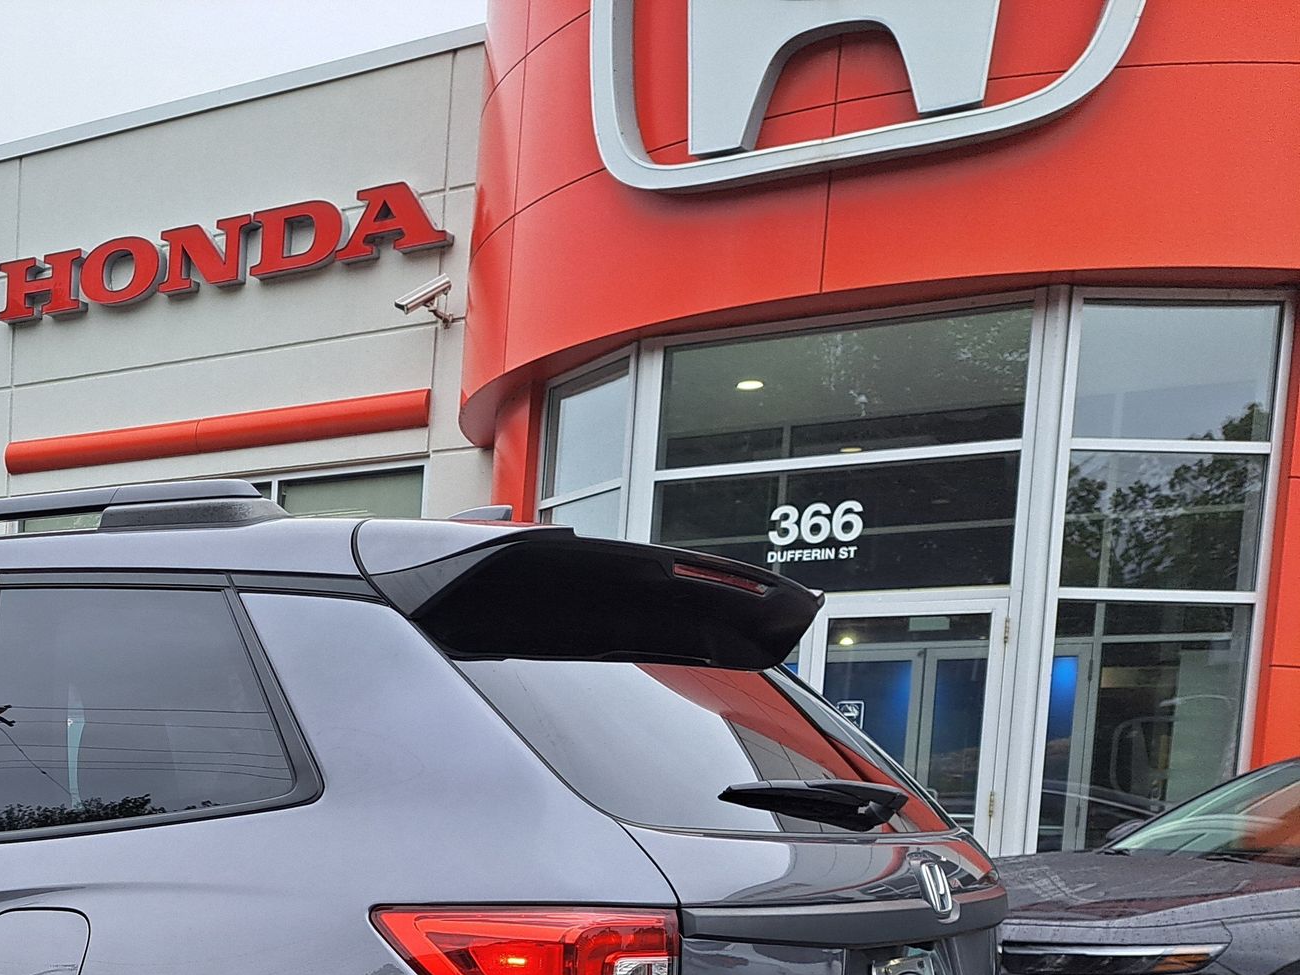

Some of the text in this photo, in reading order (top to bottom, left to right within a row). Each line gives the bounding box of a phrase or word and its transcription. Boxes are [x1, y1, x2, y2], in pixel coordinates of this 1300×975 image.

[768, 500, 863, 546] 366
[767, 546, 857, 563] DUFFERIN ST
